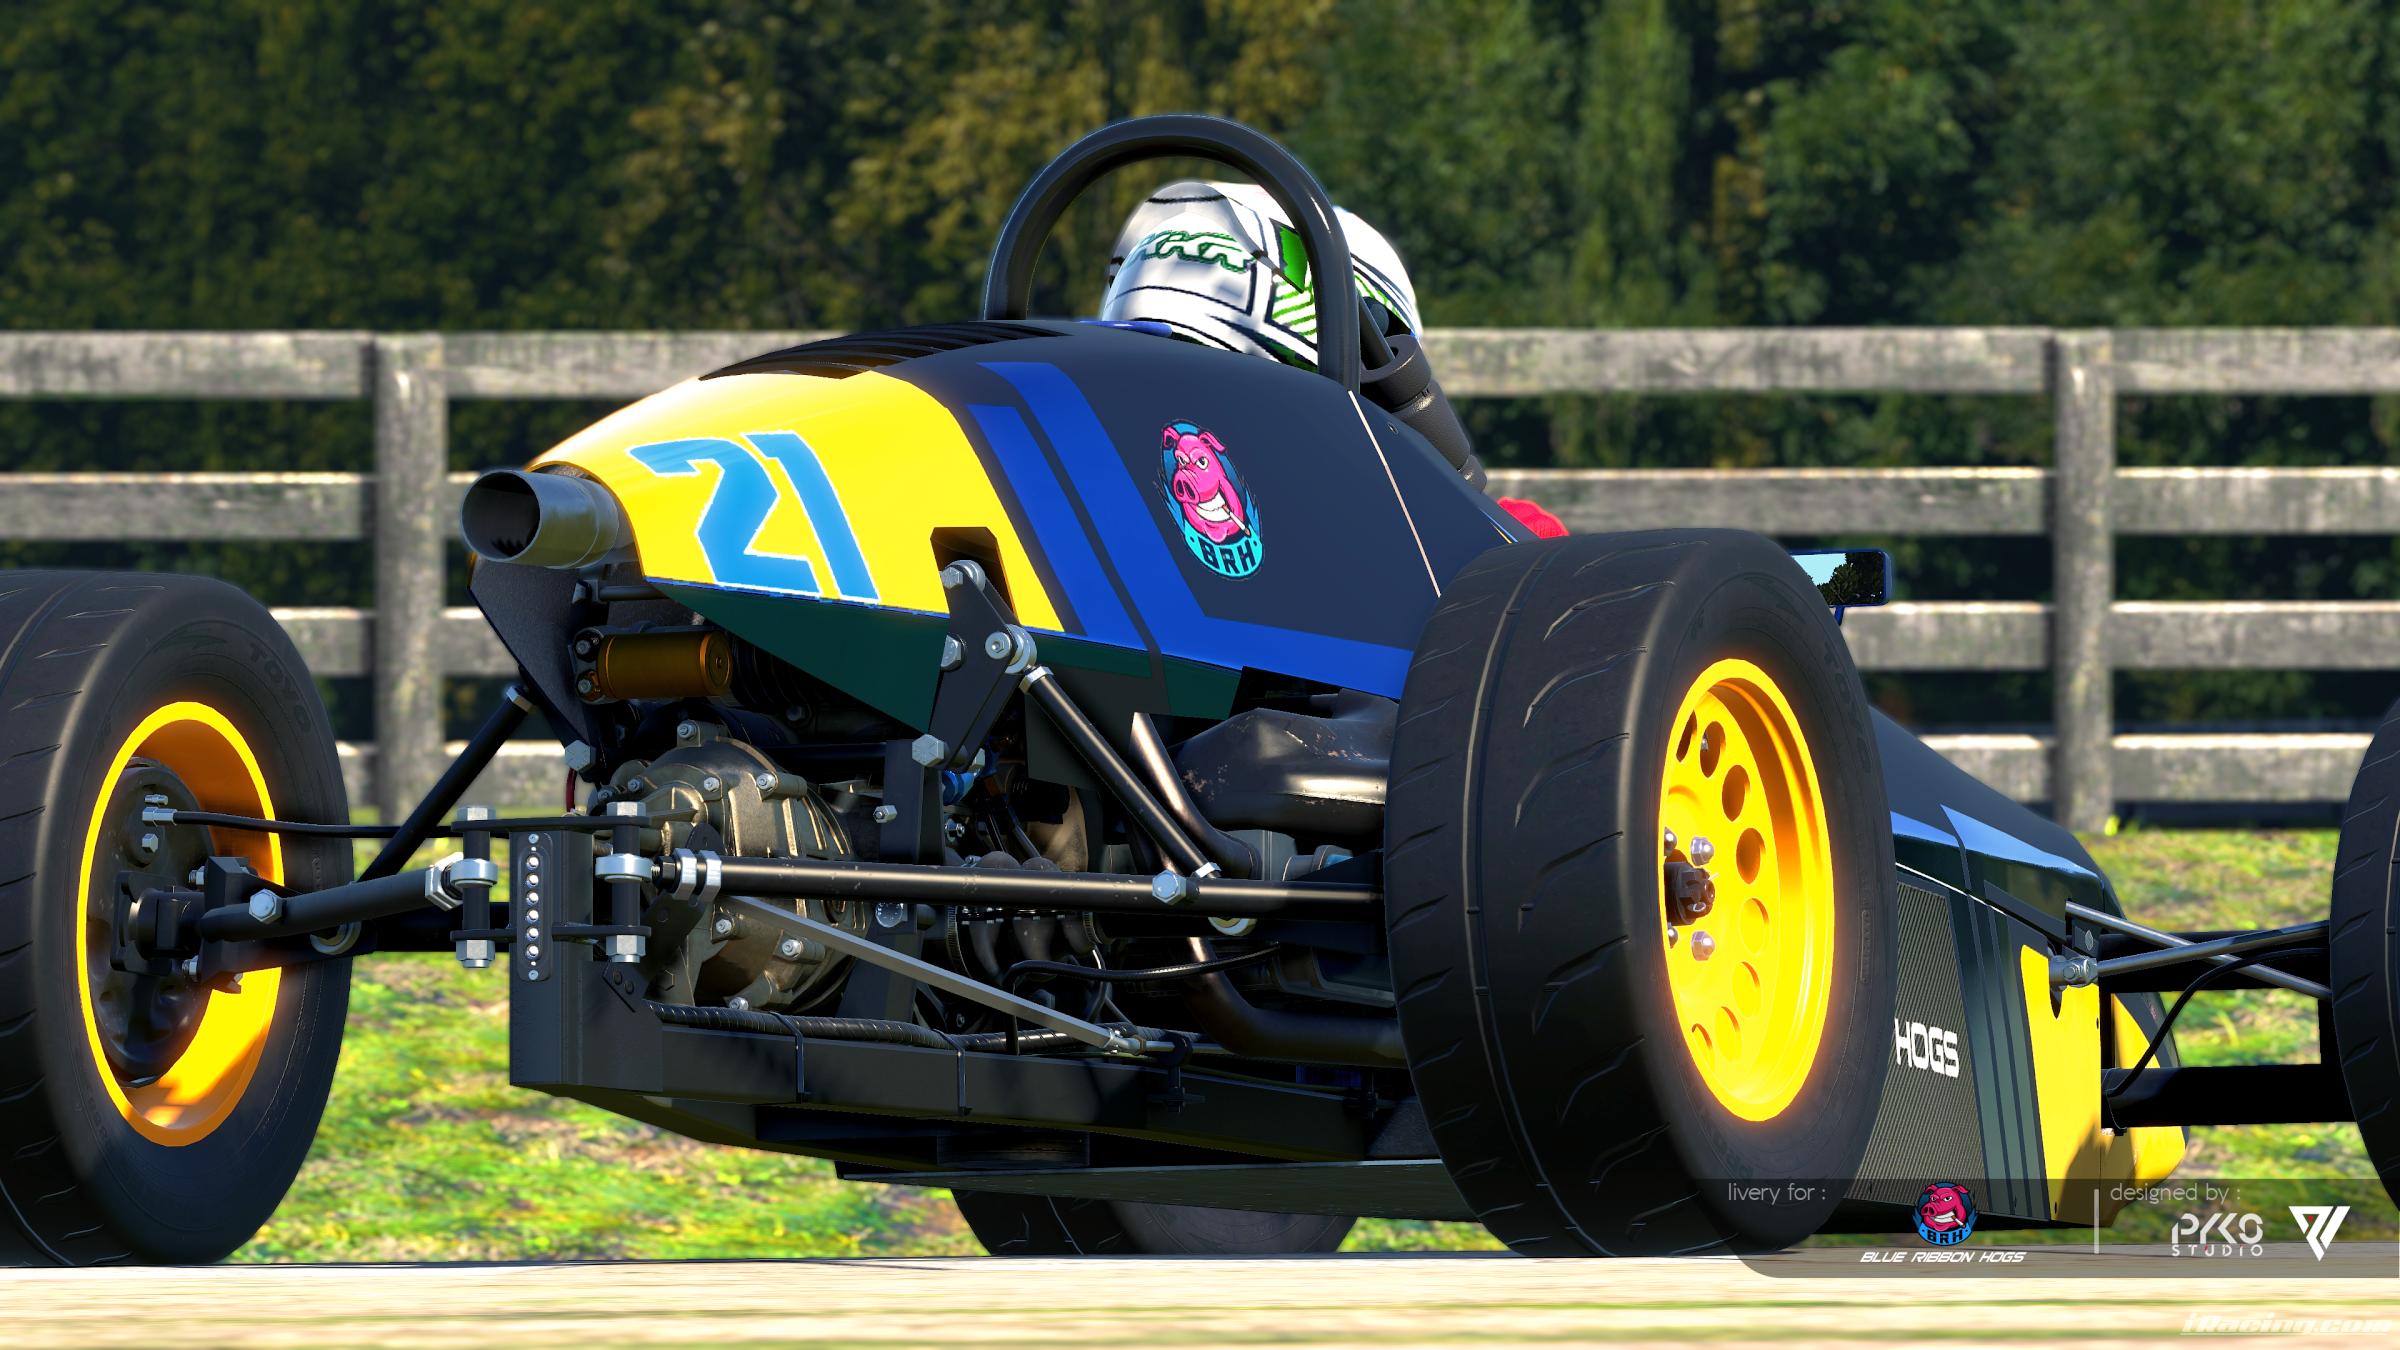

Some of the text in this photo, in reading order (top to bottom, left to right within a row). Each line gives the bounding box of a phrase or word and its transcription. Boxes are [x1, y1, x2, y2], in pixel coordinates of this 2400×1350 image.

[625, 430, 881, 604] 21
[1198, 537, 1256, 574] BRH
[250, 642, 312, 733] TOYO
[1894, 1017, 1960, 1079] HOGS
